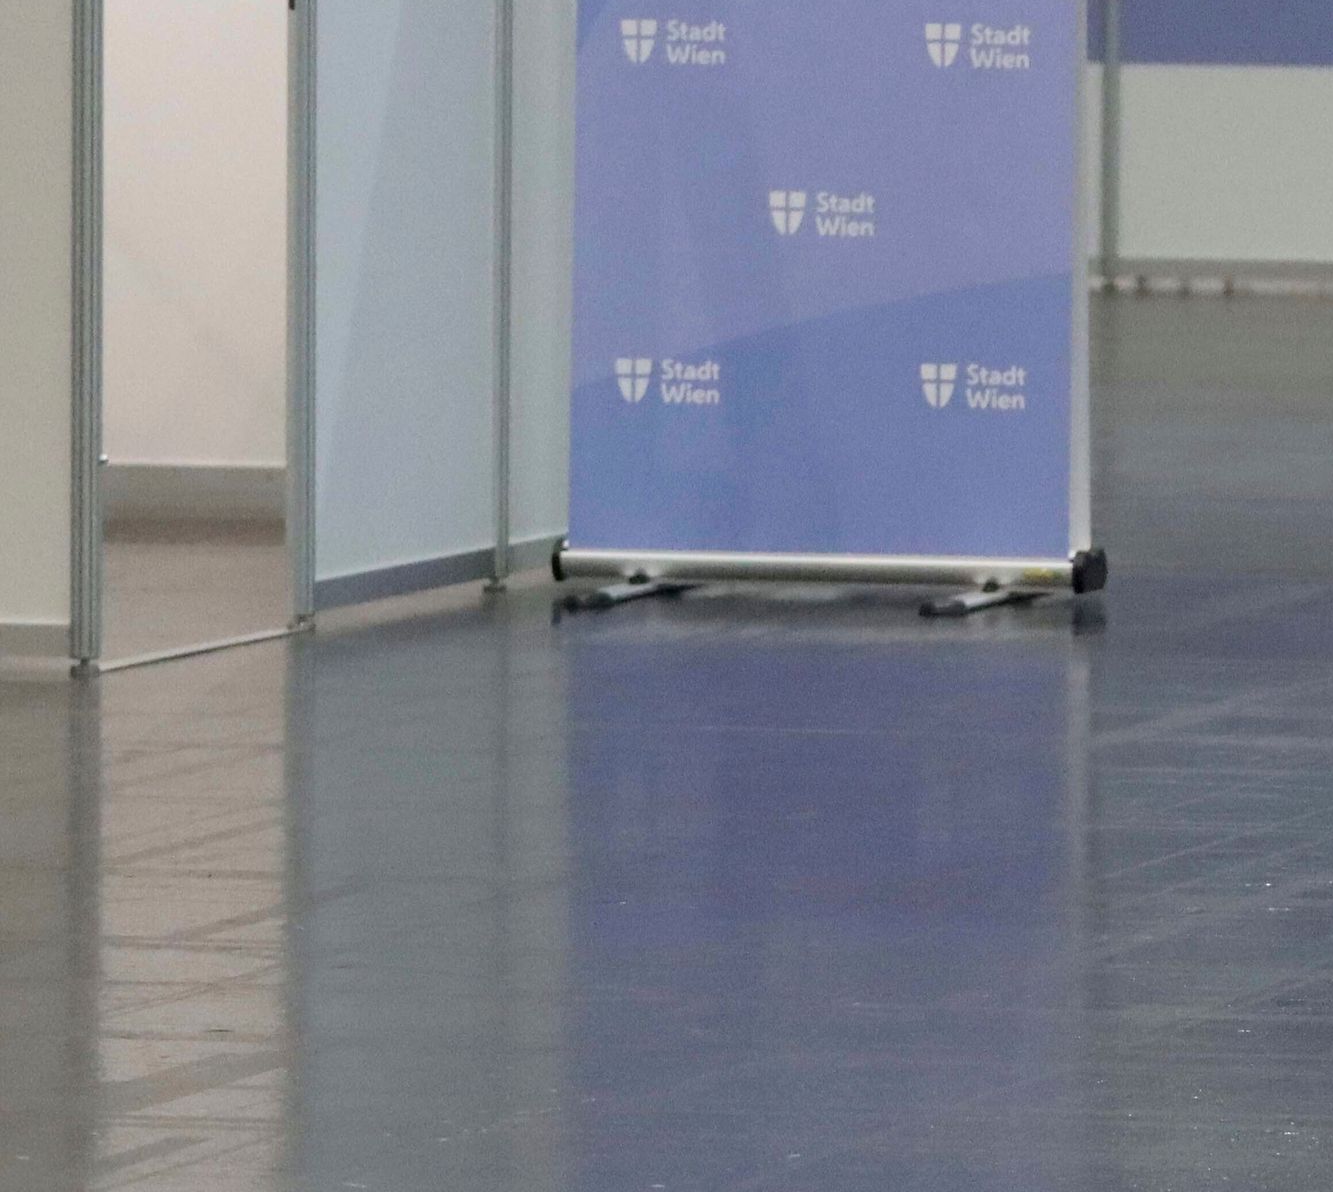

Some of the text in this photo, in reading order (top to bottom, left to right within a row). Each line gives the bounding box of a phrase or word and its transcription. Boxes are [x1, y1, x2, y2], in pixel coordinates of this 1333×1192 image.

[666, 19, 726, 43] Stadt
[971, 23, 1031, 46] Stadt
[665, 43, 726, 65] Wien
[969, 46, 1030, 69] Wien
[816, 191, 875, 214] Stadt
[815, 215, 874, 237] Wien
[661, 358, 720, 382] Stadt
[966, 363, 1026, 386] Stadt
[660, 382, 720, 405] Wien
[965, 388, 1026, 410] Wien
